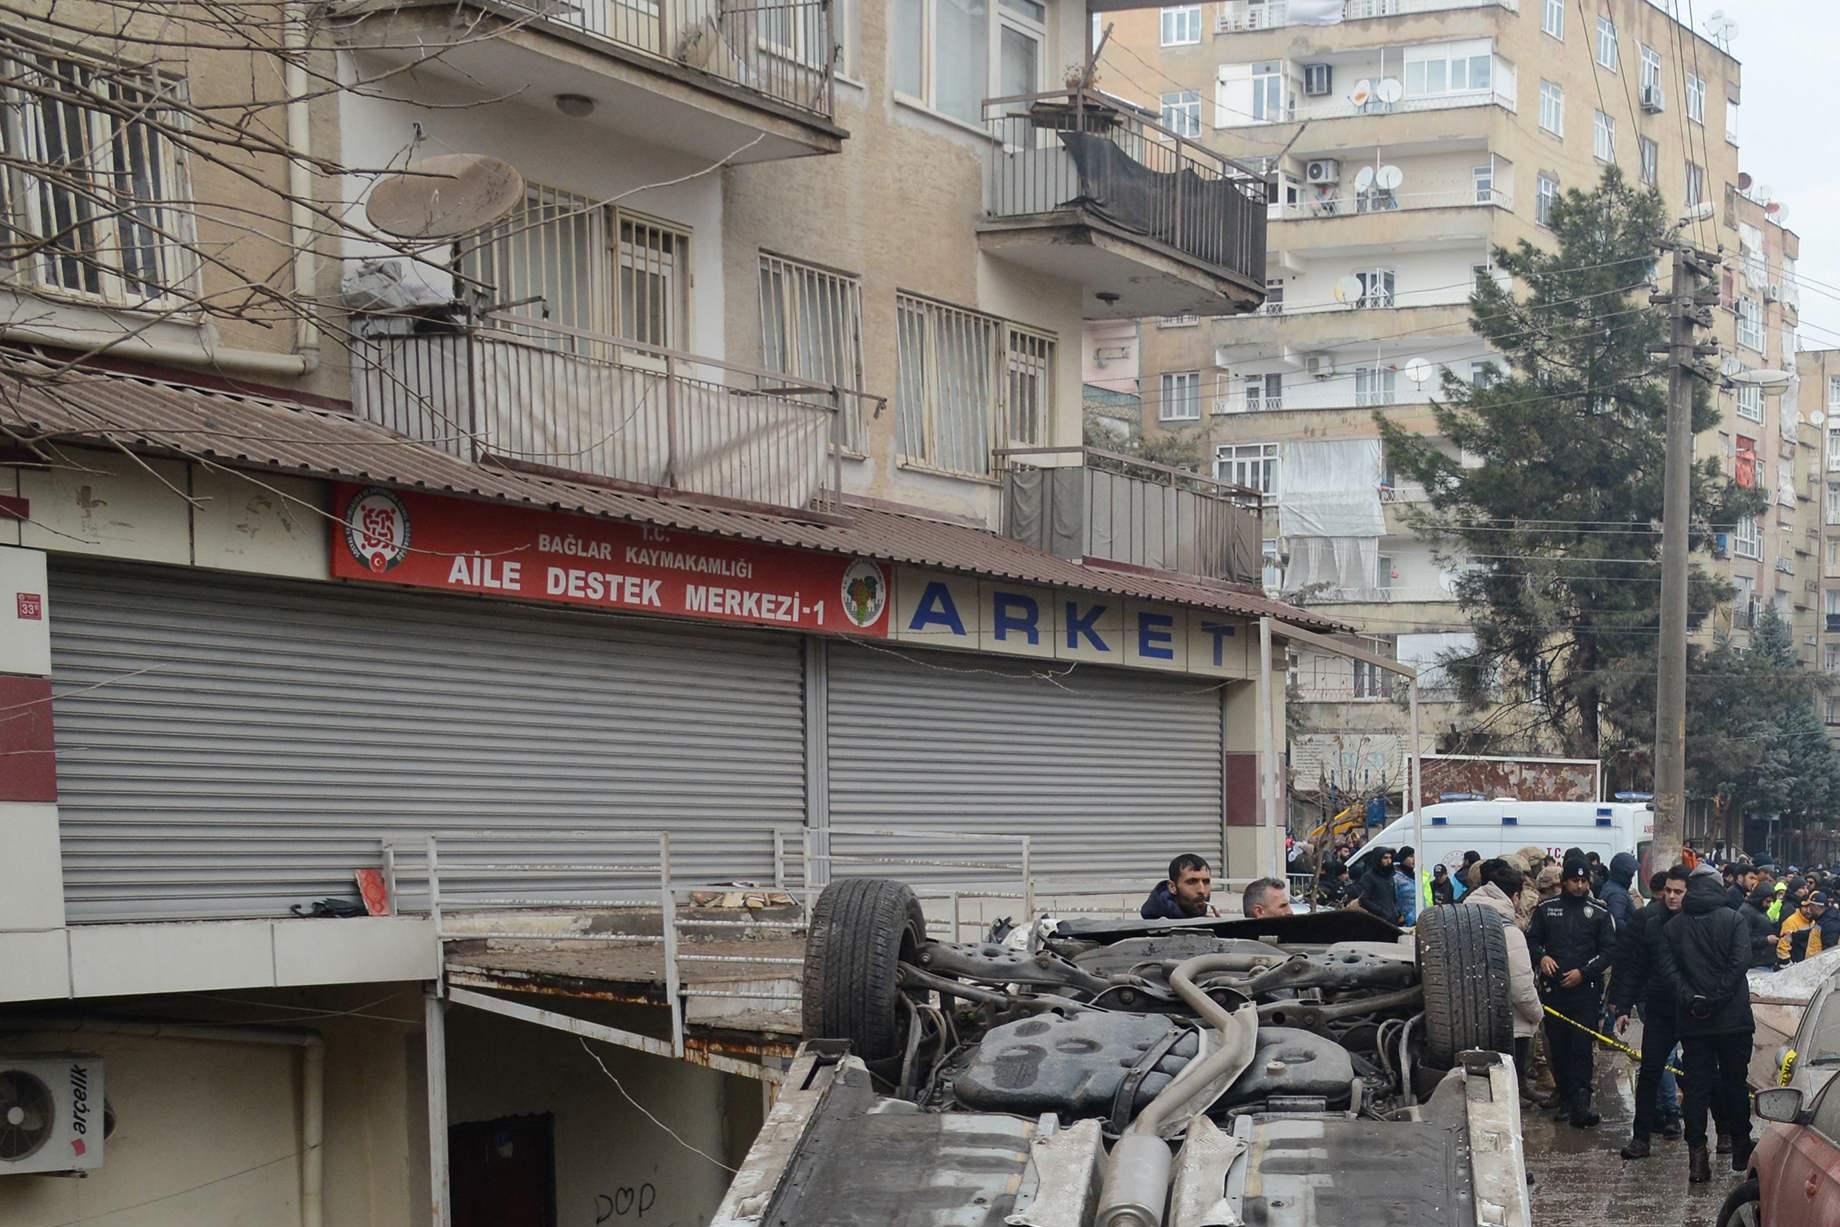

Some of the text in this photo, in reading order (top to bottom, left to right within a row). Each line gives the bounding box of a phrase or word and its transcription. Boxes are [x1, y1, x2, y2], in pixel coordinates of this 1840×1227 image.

[448, 550, 824, 625] AİLE DESTEK MERKEZİ-1
[538, 534, 753, 578] BAĞLAR KAYMAKAMLIĞI
[70, 1064, 90, 1135] arçelik
